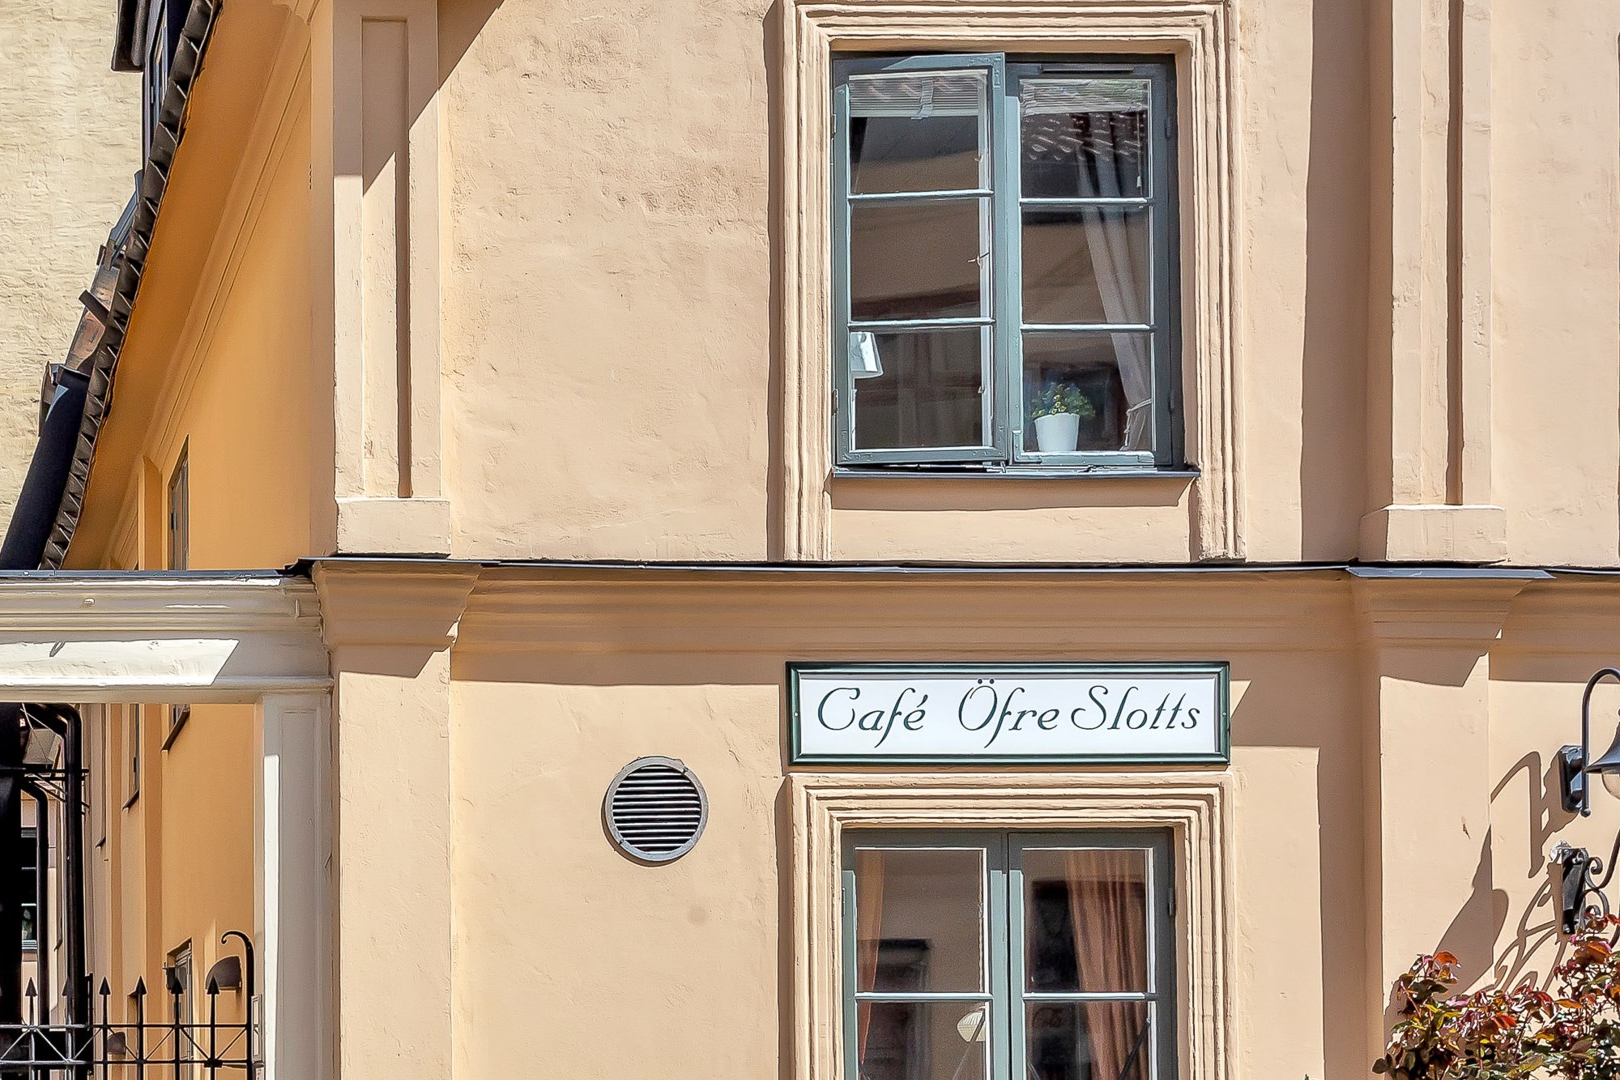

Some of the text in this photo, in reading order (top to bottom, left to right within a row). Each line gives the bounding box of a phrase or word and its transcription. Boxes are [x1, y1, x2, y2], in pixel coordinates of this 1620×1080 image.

[817, 678, 1202, 749] Café Öfre Slotts
